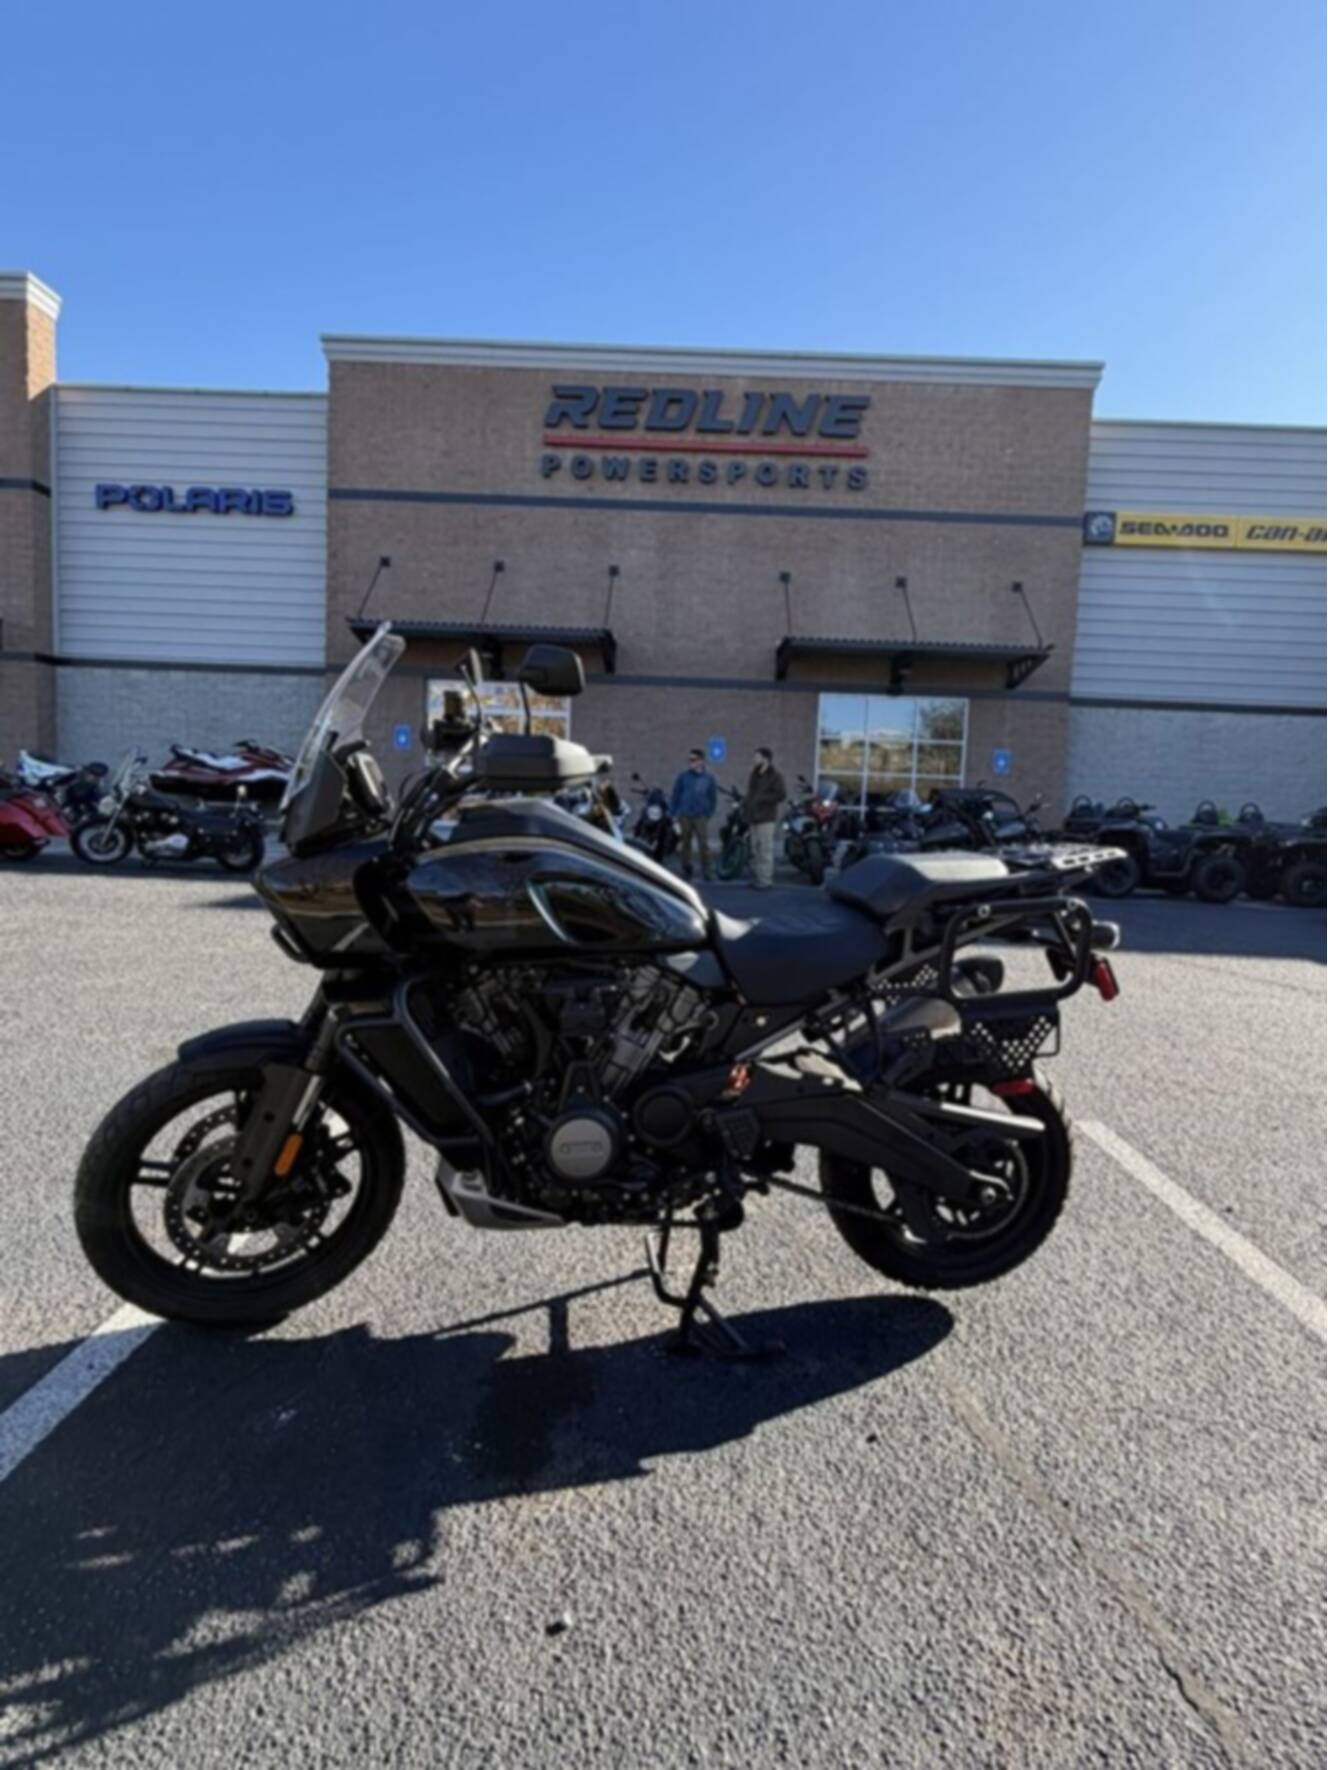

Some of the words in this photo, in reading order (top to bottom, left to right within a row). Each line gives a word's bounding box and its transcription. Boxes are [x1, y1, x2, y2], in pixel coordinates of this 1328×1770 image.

[543, 384, 872, 439] REDLINE
[542, 454, 868, 491] POWERSPORTS
[95, 483, 297, 517] POLARIS
